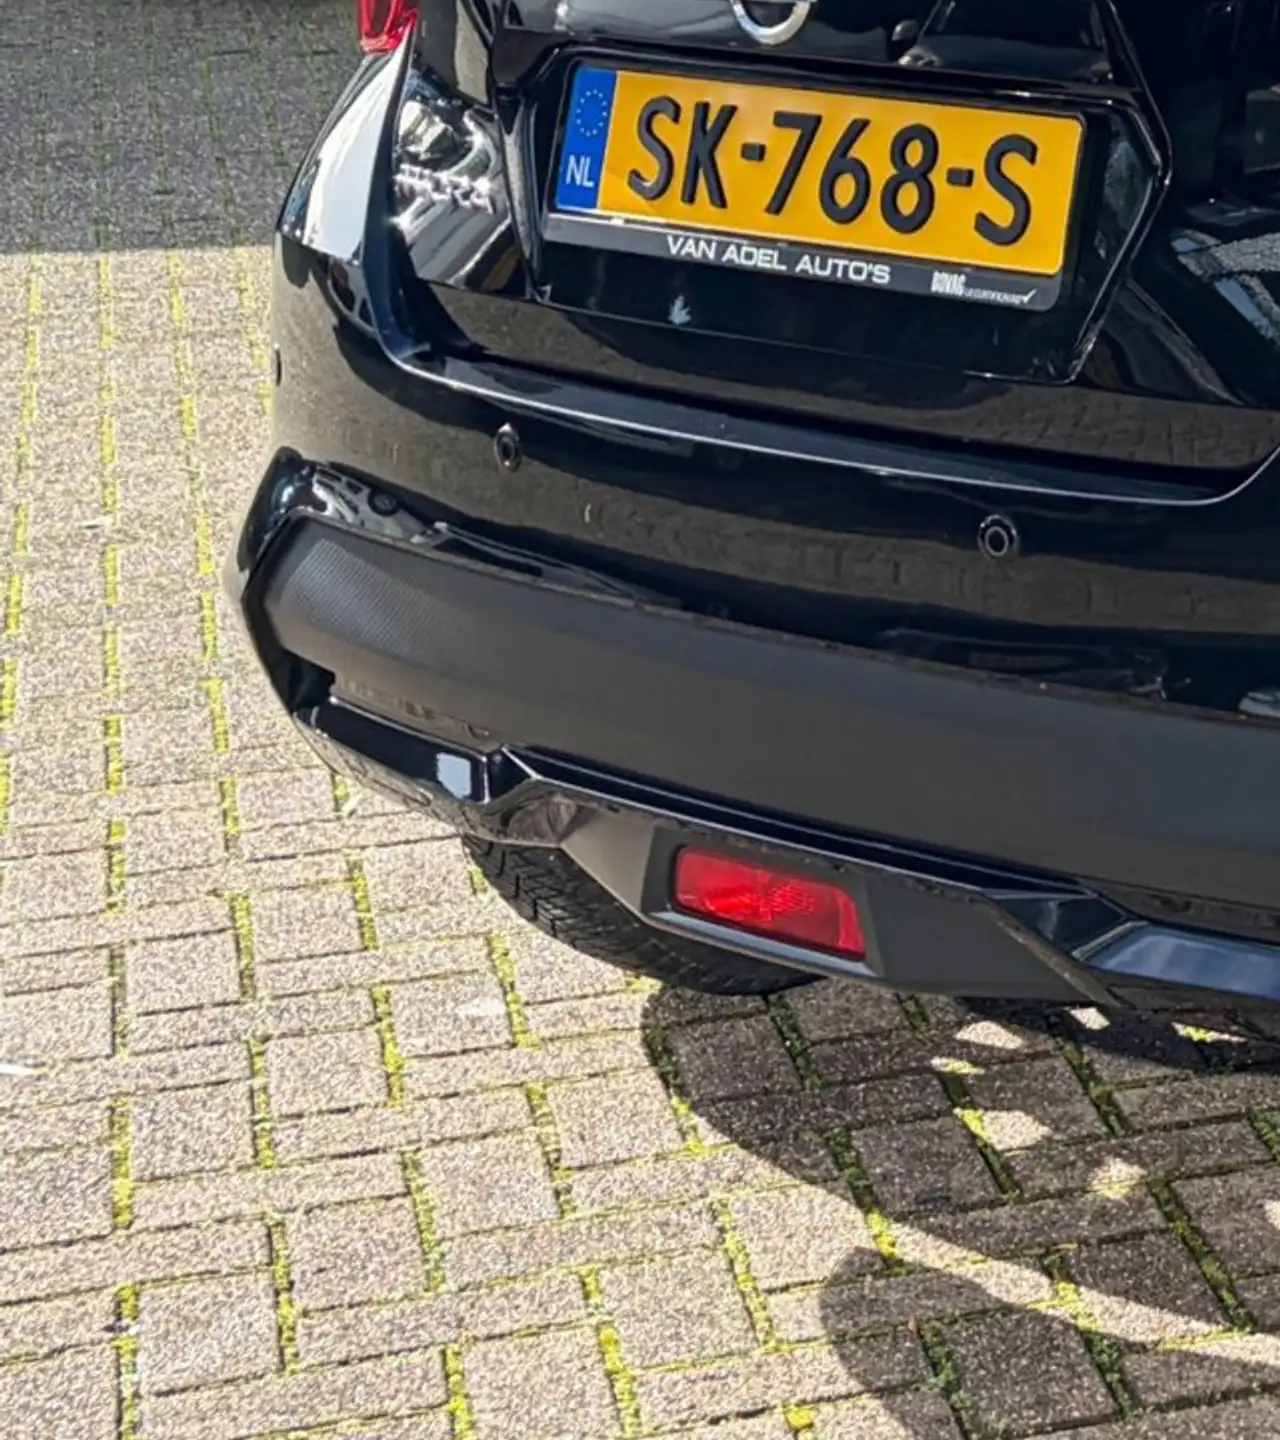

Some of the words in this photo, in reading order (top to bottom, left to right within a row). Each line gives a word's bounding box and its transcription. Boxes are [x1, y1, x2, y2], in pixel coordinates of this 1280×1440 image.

[565, 154, 596, 189] NL
[626, 95, 1040, 246] SK-768-S
[667, 235, 717, 260] VAN
[721, 245, 787, 271] ADEL
[795, 254, 892, 285] AUTO'S
